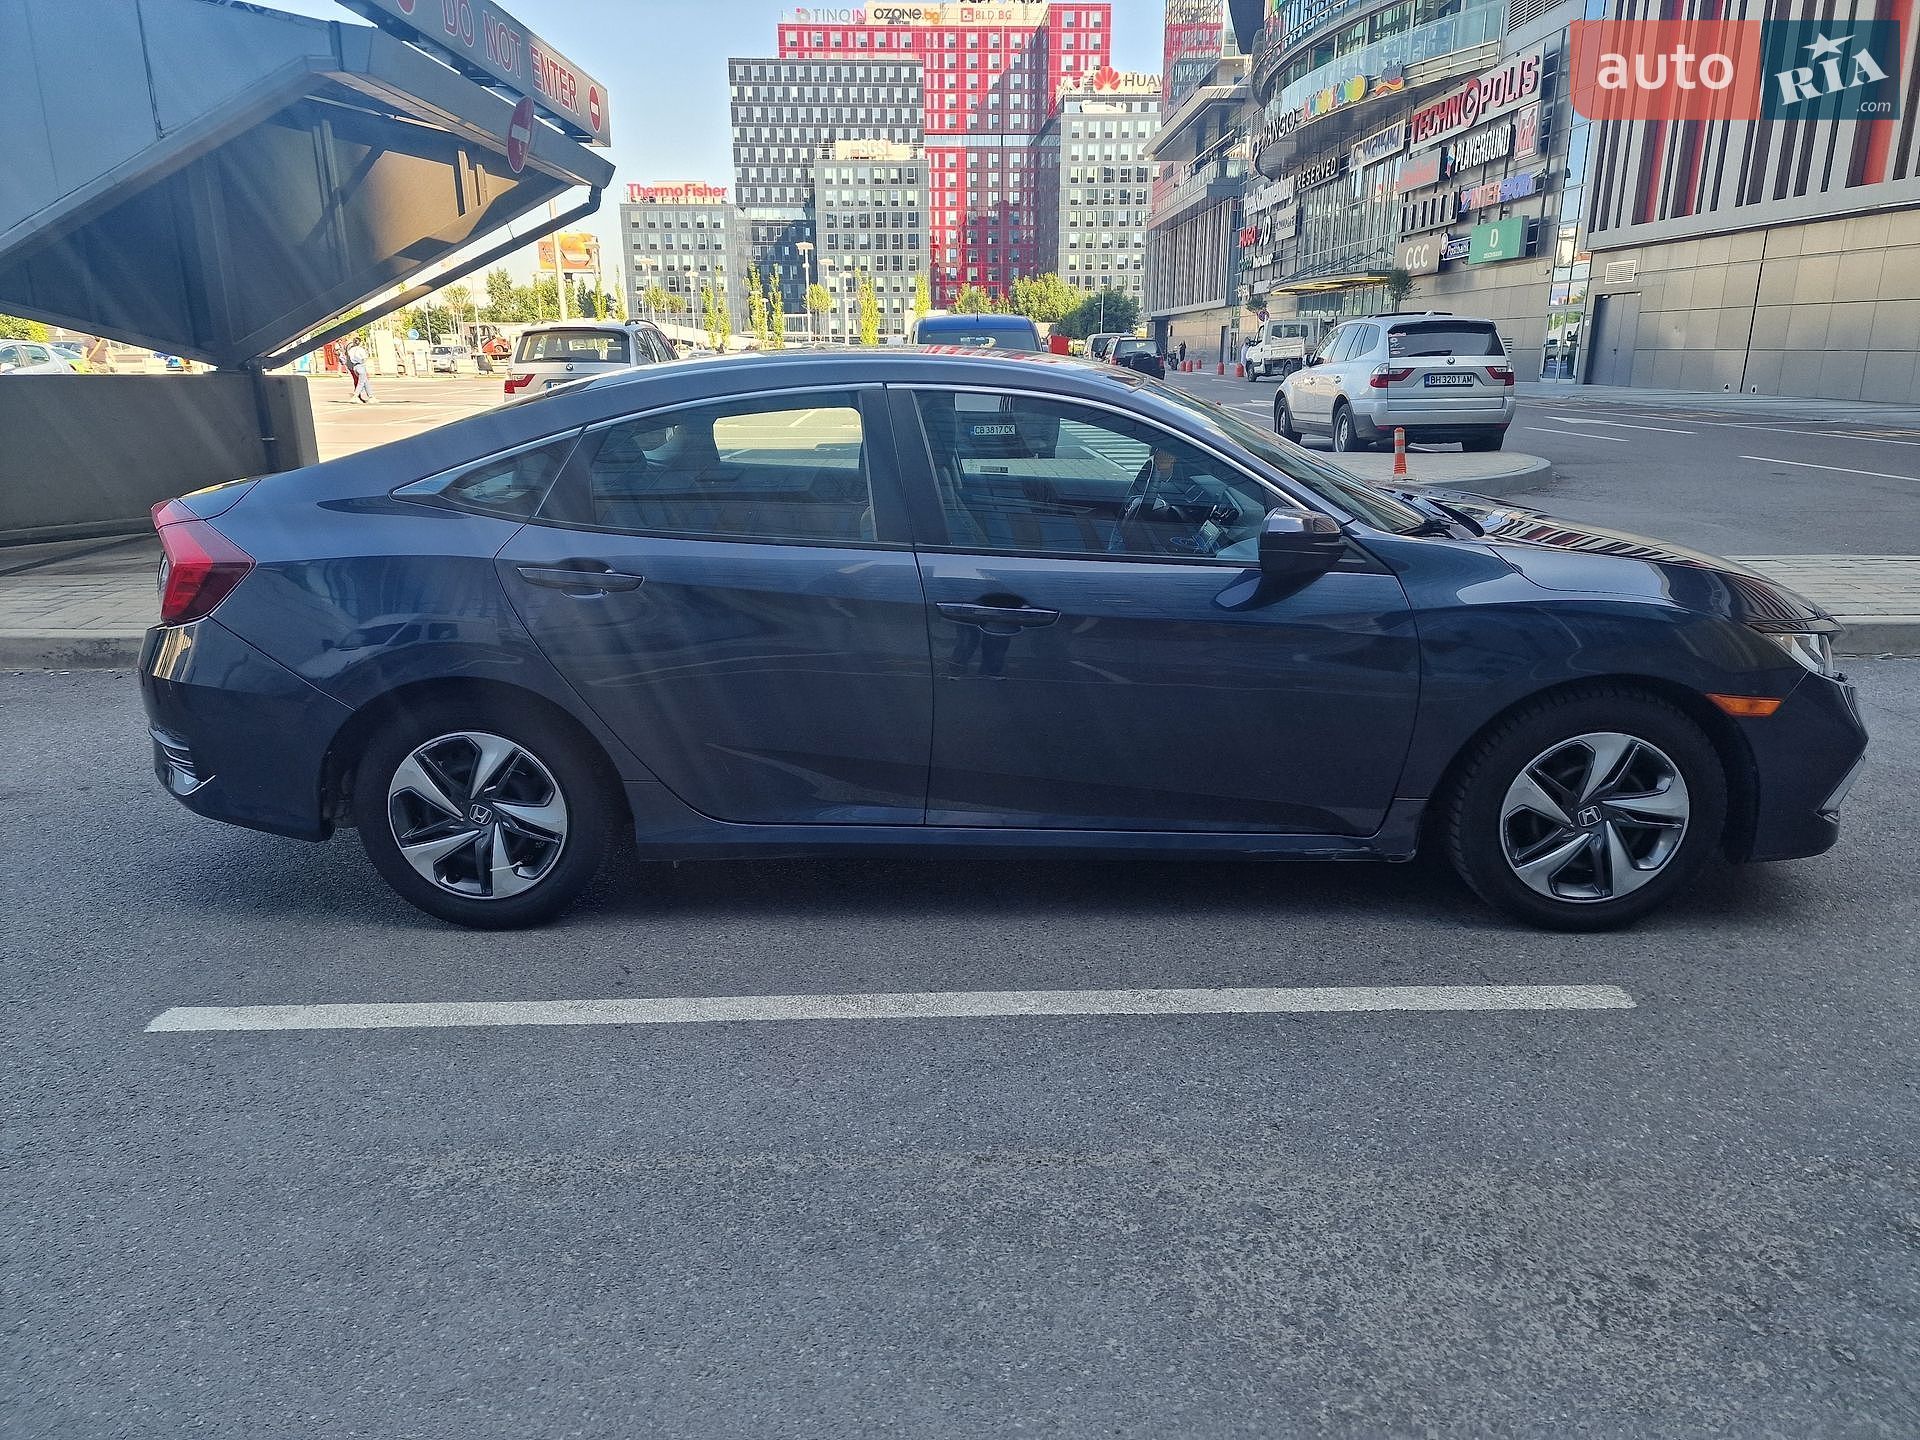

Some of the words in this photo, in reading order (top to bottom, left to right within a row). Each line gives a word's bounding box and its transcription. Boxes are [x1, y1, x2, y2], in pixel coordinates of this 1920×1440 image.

[442, 0, 475, 47] DO
[483, 10, 521, 79] NOT
[529, 44, 580, 116] ENTER
[1455, 124, 1512, 170] PLAYGROUND
[1296, 157, 1338, 189] RESERVED
[627, 184, 683, 197] Thermo
[684, 184, 728, 197] Fisher
[1405, 243, 1430, 271] CCC
